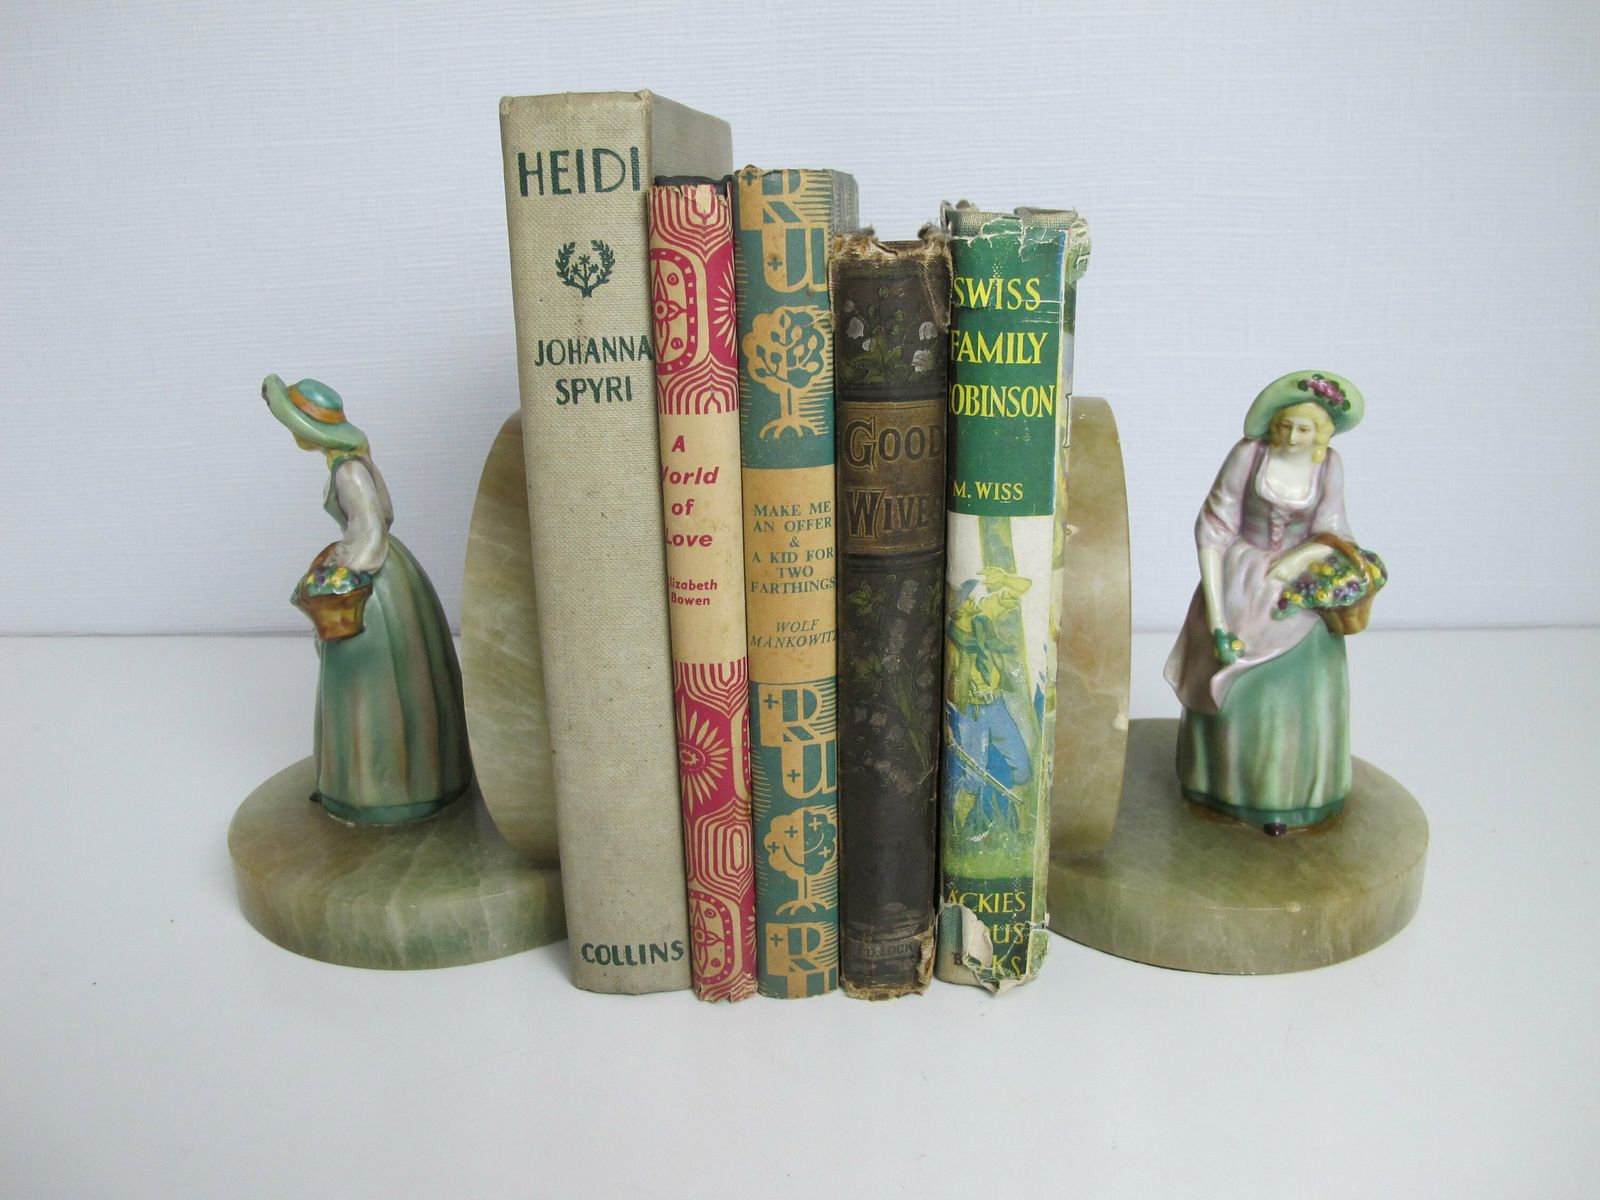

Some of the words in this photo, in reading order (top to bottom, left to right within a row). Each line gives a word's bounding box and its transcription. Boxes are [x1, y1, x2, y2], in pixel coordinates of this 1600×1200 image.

[518, 146, 640, 196] HEIDI
[953, 276, 1041, 311] SWISS
[534, 335, 653, 366] JOHANNA
[951, 330, 1049, 364] FAMILY
[555, 376, 633, 405] SPYRI
[950, 383, 1055, 418] OBINSON
[671, 435, 686, 452] A
[843, 416, 943, 472] GOOD
[953, 480, 972, 499] M.
[975, 481, 1025, 500] WISS
[671, 498, 695, 516] of
[753, 504, 801, 517] MAKE
[809, 501, 832, 515] ME
[844, 488, 937, 539] WIVE
[753, 520, 775, 532] AN
[784, 516, 832, 532] OFFER
[665, 527, 713, 547] Love
[789, 536, 800, 548] &
[751, 551, 761, 562] A
[769, 551, 798, 563] KID
[806, 547, 834, 562] FOR
[776, 566, 814, 578] TWO
[668, 576, 718, 590] lizabeth
[751, 576, 837, 594] FARTHINGS
[671, 592, 710, 605] Bowen
[776, 619, 819, 632] WOLF
[946, 889, 1026, 913] ACKIES
[581, 940, 685, 966] COLLINS
